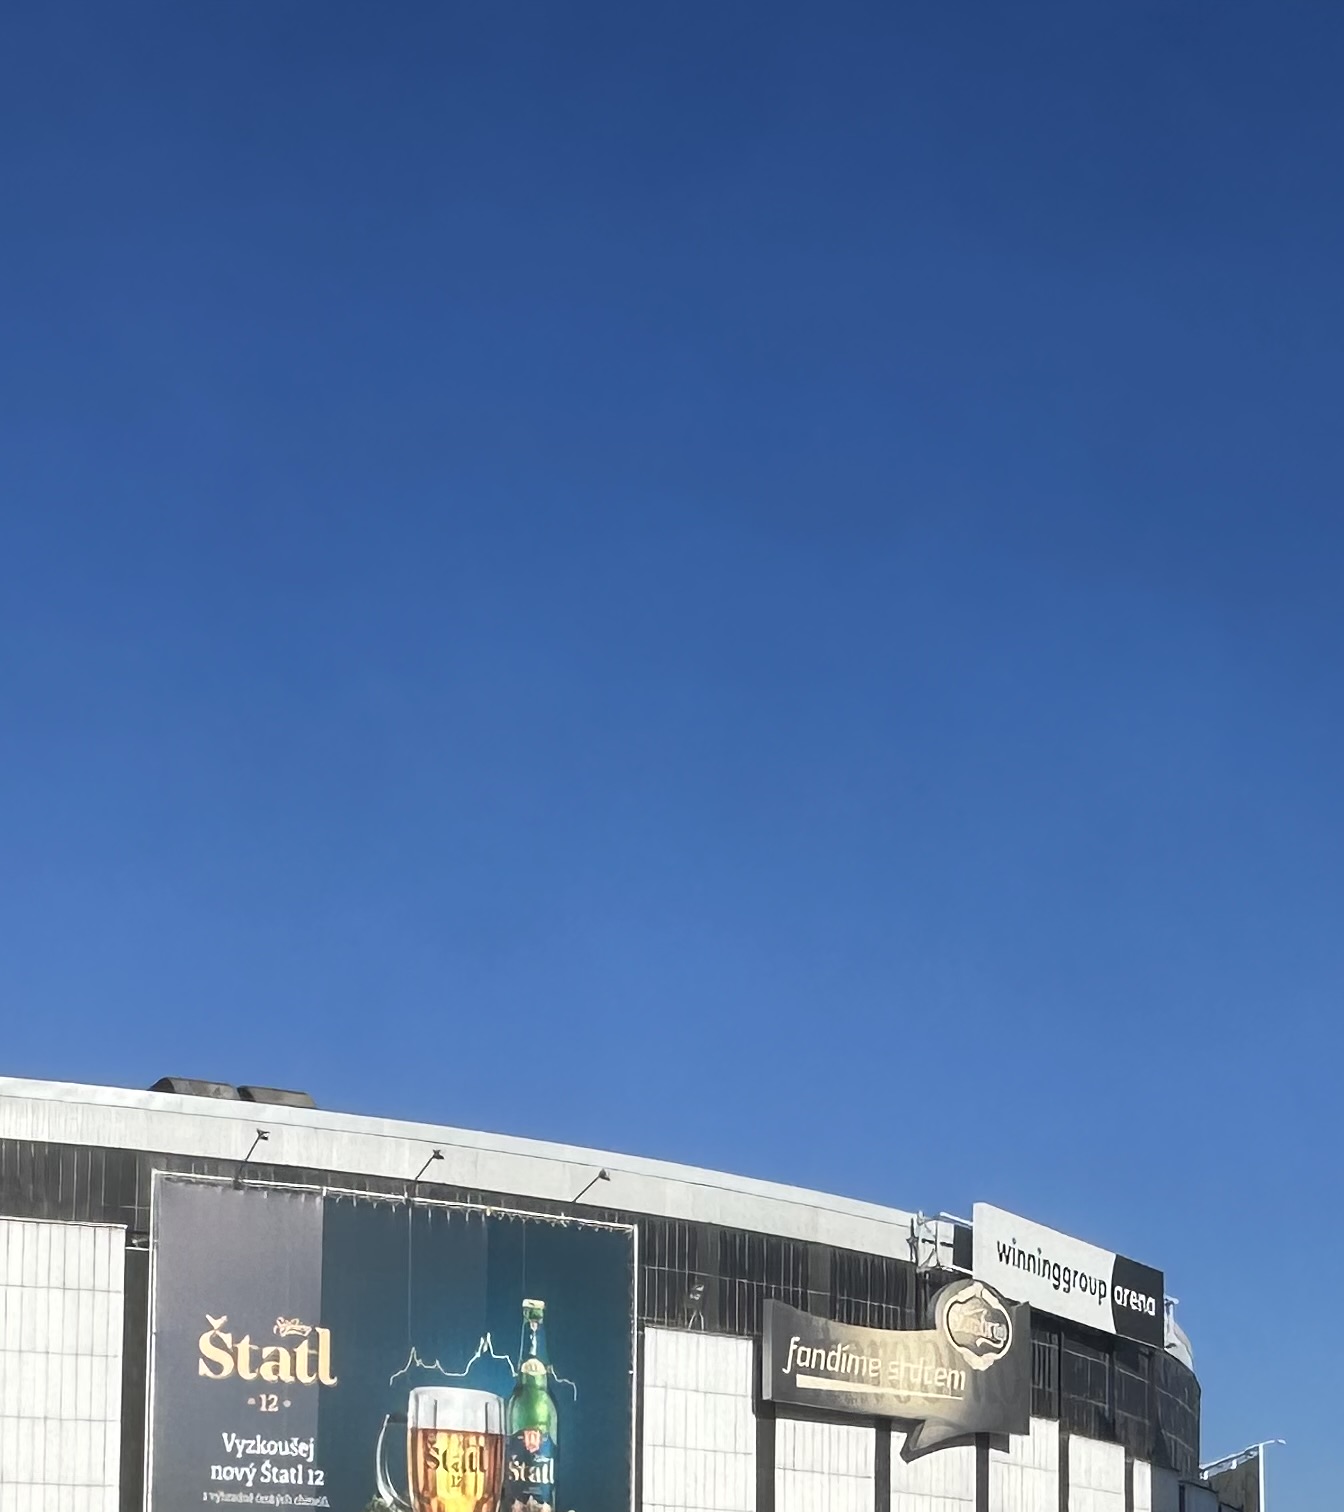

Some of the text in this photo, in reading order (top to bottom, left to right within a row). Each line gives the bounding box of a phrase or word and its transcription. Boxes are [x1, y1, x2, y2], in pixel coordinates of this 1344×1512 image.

[996, 1237, 1156, 1316] winninggroup arena
[198, 1313, 338, 1386] Štatl
[782, 1336, 882, 1377] fandíme
[259, 1394, 279, 1412] 12
[221, 1432, 315, 1462] Vyzkoušej
[210, 1460, 325, 1487] nový Štatl 12
